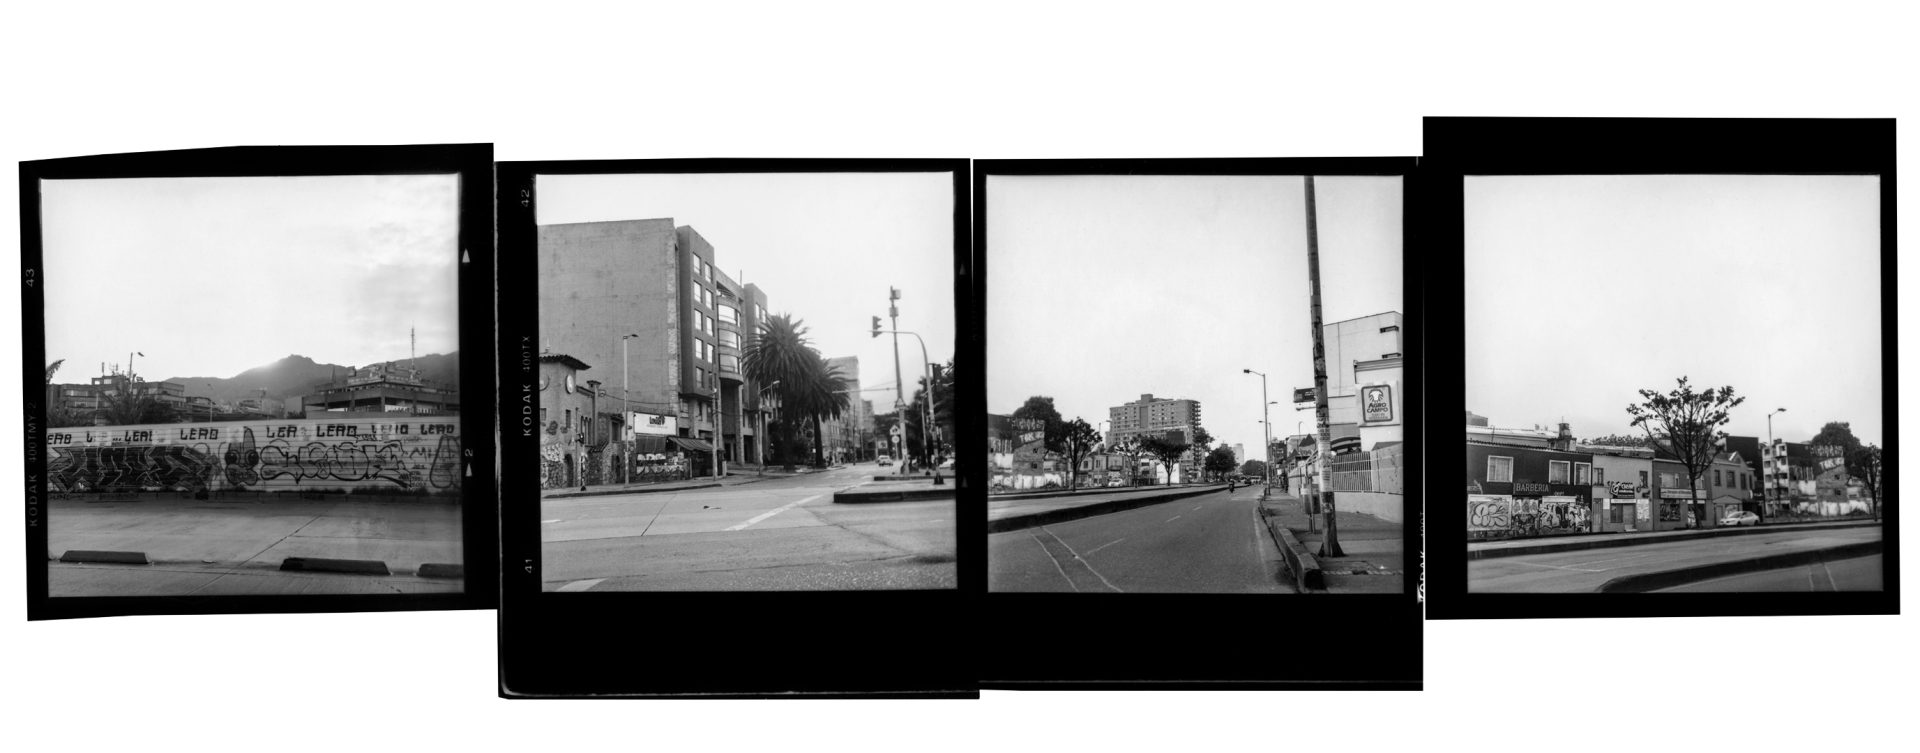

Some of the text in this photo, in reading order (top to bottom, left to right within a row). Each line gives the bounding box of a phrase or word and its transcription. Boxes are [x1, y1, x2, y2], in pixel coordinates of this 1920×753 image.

[521, 189, 530, 207] 42
[25, 268, 35, 288] 43
[522, 383, 532, 437] KODAK
[464, 448, 474, 457] 2
[1516, 483, 1549, 493] BARBERIA
[28, 473, 39, 528] KODAK
[524, 558, 533, 574] 41
